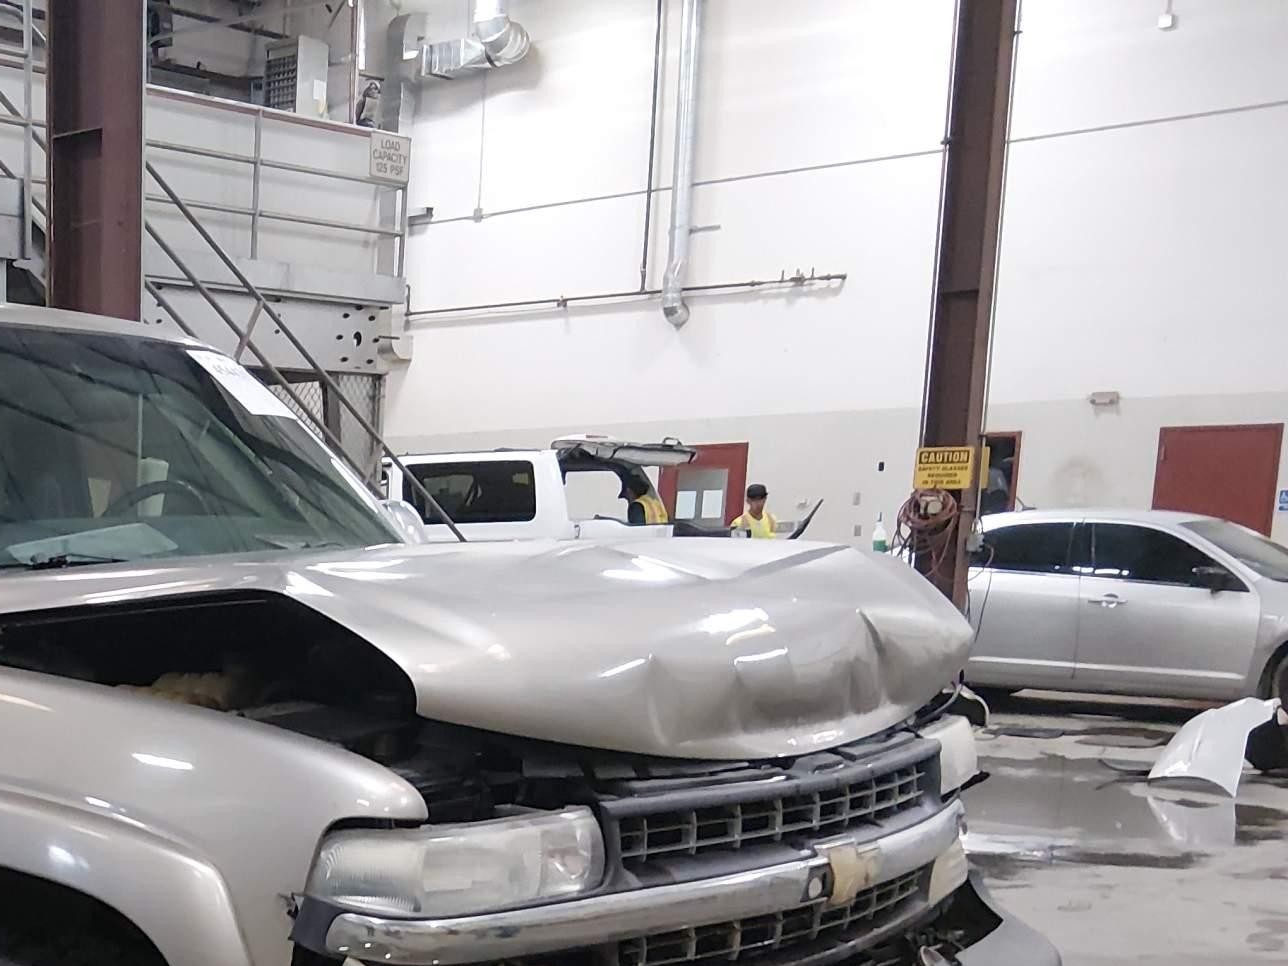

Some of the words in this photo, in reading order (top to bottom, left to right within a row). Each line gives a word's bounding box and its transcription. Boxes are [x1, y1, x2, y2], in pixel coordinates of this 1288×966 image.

[381, 139, 401, 152] LOAD
[373, 148, 408, 165] CAPACITY
[376, 162, 388, 173] 125
[921, 451, 969, 464] CAUTION
